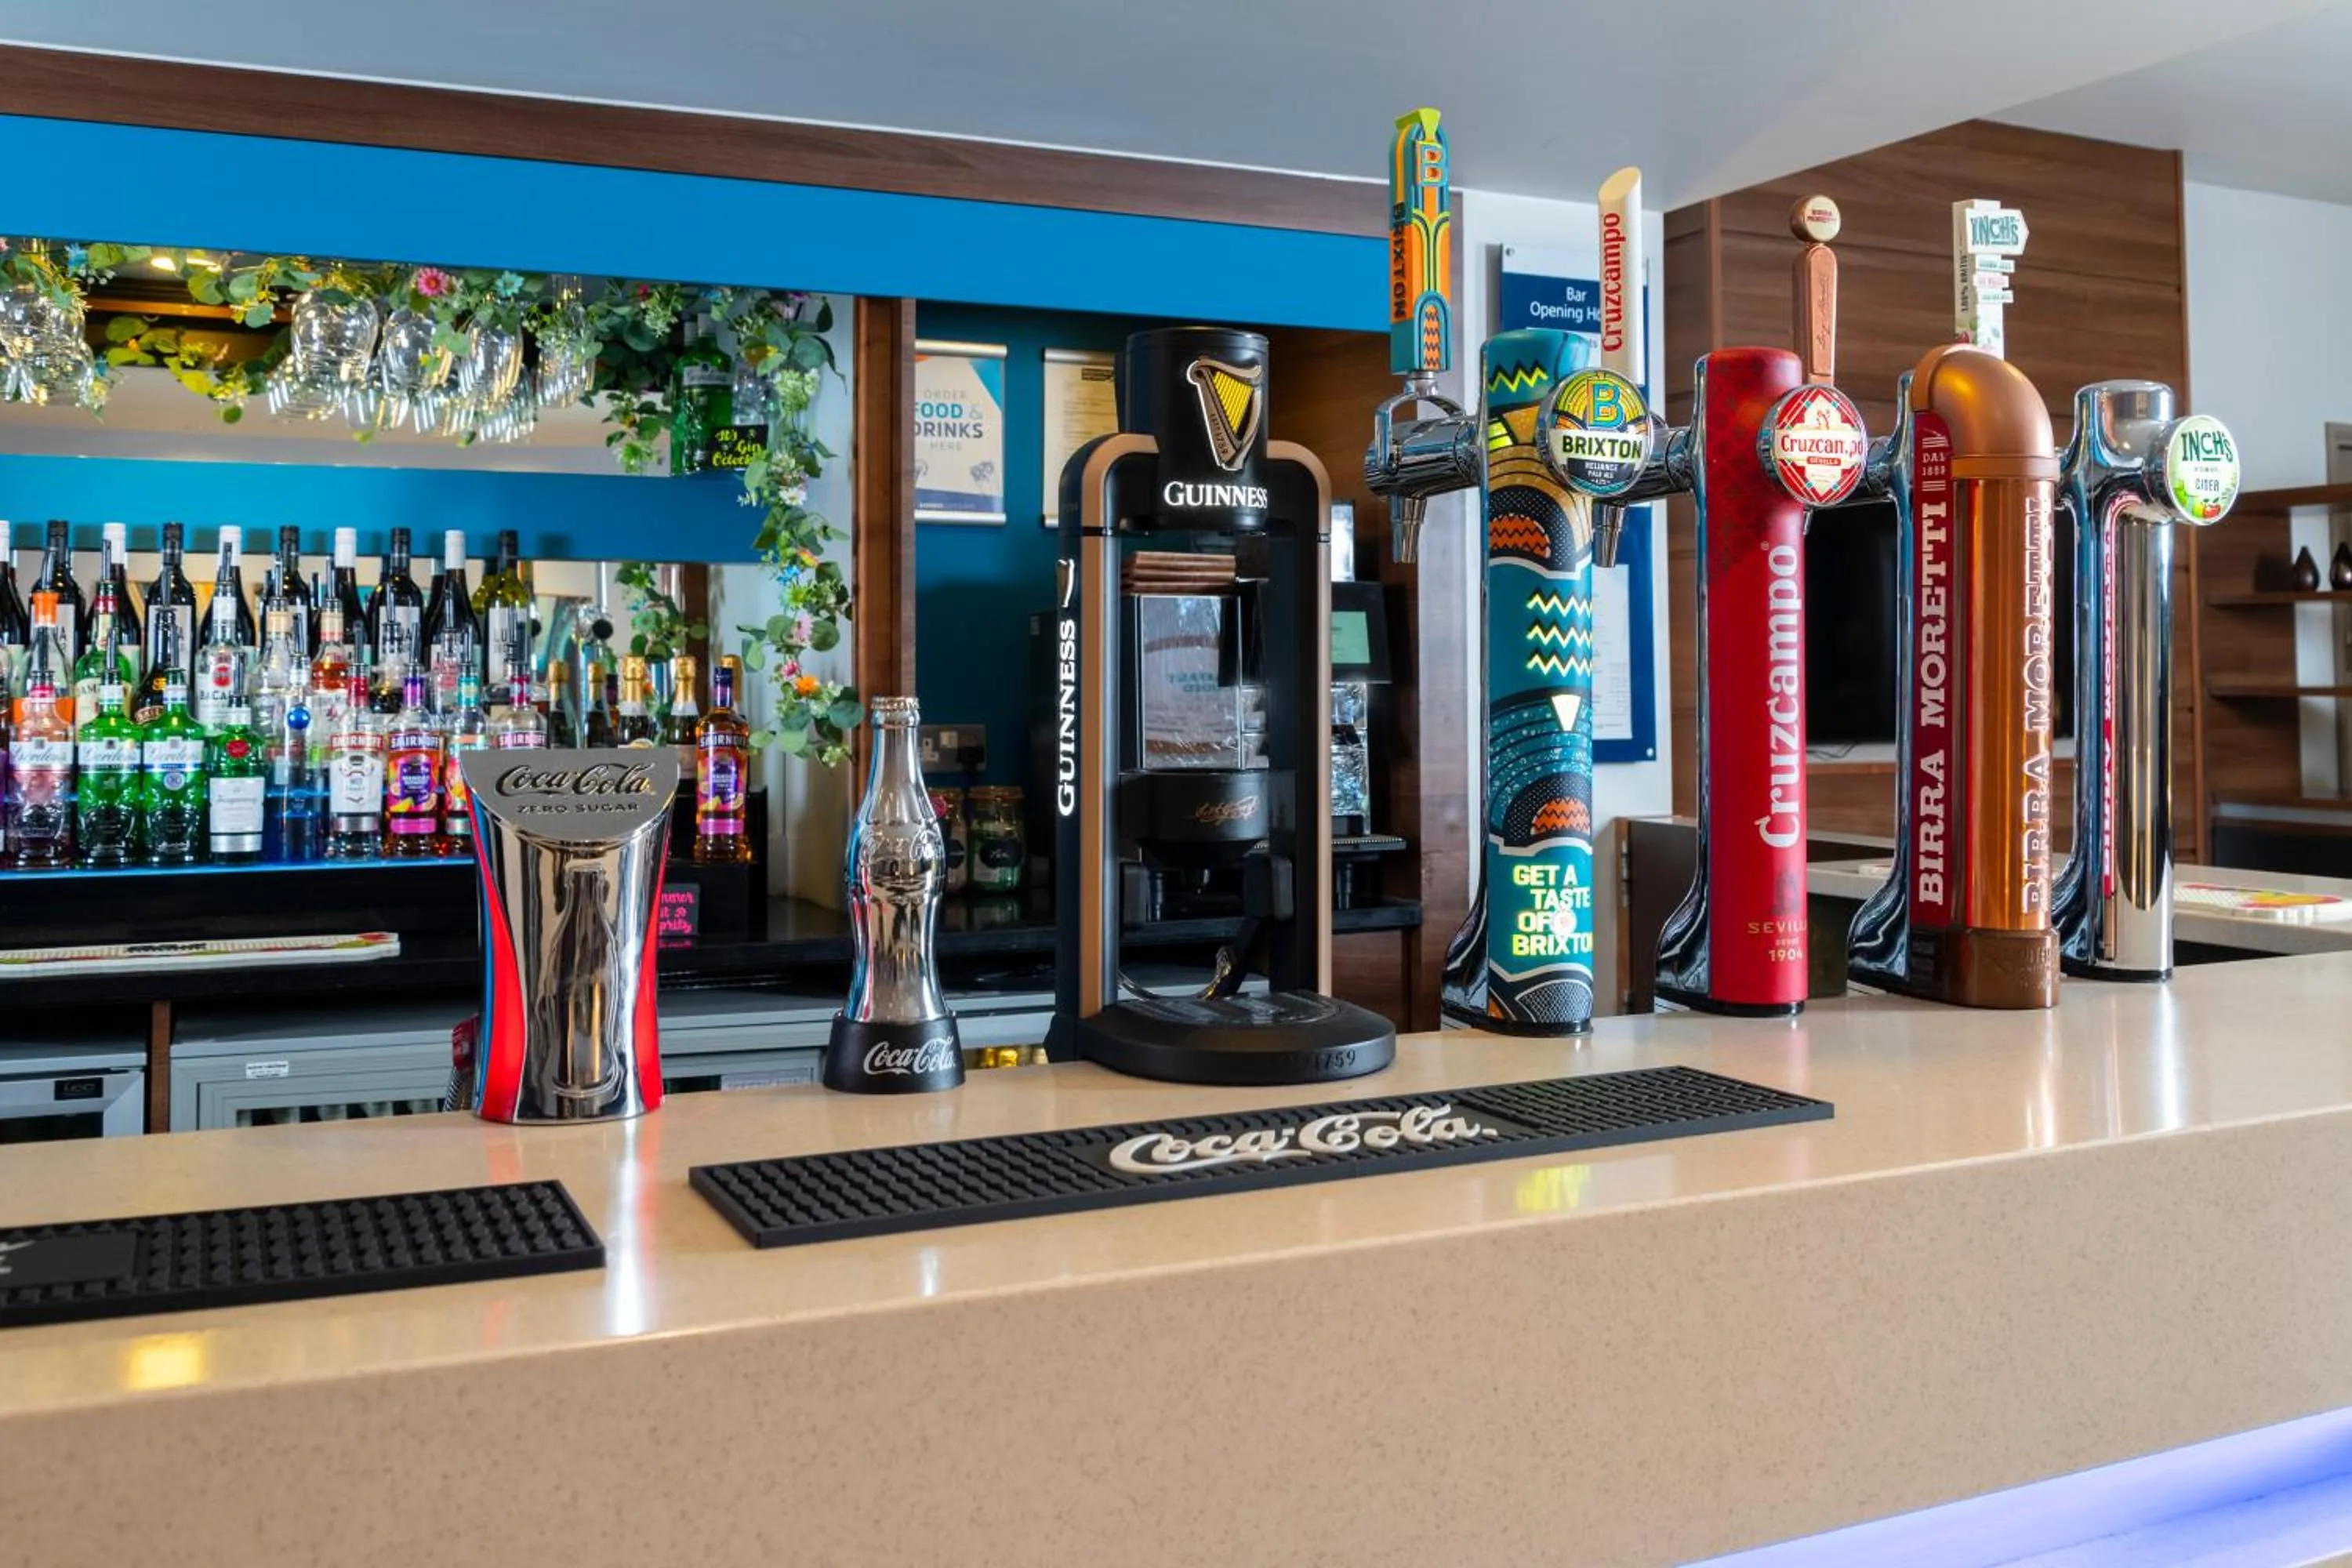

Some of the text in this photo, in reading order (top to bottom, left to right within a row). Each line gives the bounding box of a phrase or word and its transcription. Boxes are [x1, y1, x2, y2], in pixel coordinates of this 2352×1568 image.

[1566, 286, 1588, 302] Bar
[1601, 212, 1626, 352] Cruzcampo
[1530, 300, 1584, 324] Opening
[1563, 435, 1642, 459] BRIXTON
[2180, 430, 2233, 463] INCH'S
[1163, 481, 1268, 509] GUINNESS
[1754, 544, 1802, 848] Cruzcampo
[1918, 501, 1947, 906] BIRRA MORETTI
[1058, 619, 1075, 816] GUINNESS
[391, 735, 440, 749] SMIRNOFF
[499, 732, 547, 746] SMIRNOFF
[495, 763, 656, 797] Coca-Cola
[517, 803, 639, 814] ZERO SUGAR
[1512, 864, 1578, 887] GET A
[1530, 887, 1591, 910] TASTE
[1512, 932, 1593, 956] BRIXTO
[863, 1036, 955, 1076] Coca-Cola
[1109, 1102, 1482, 1174] Coca-Cola
